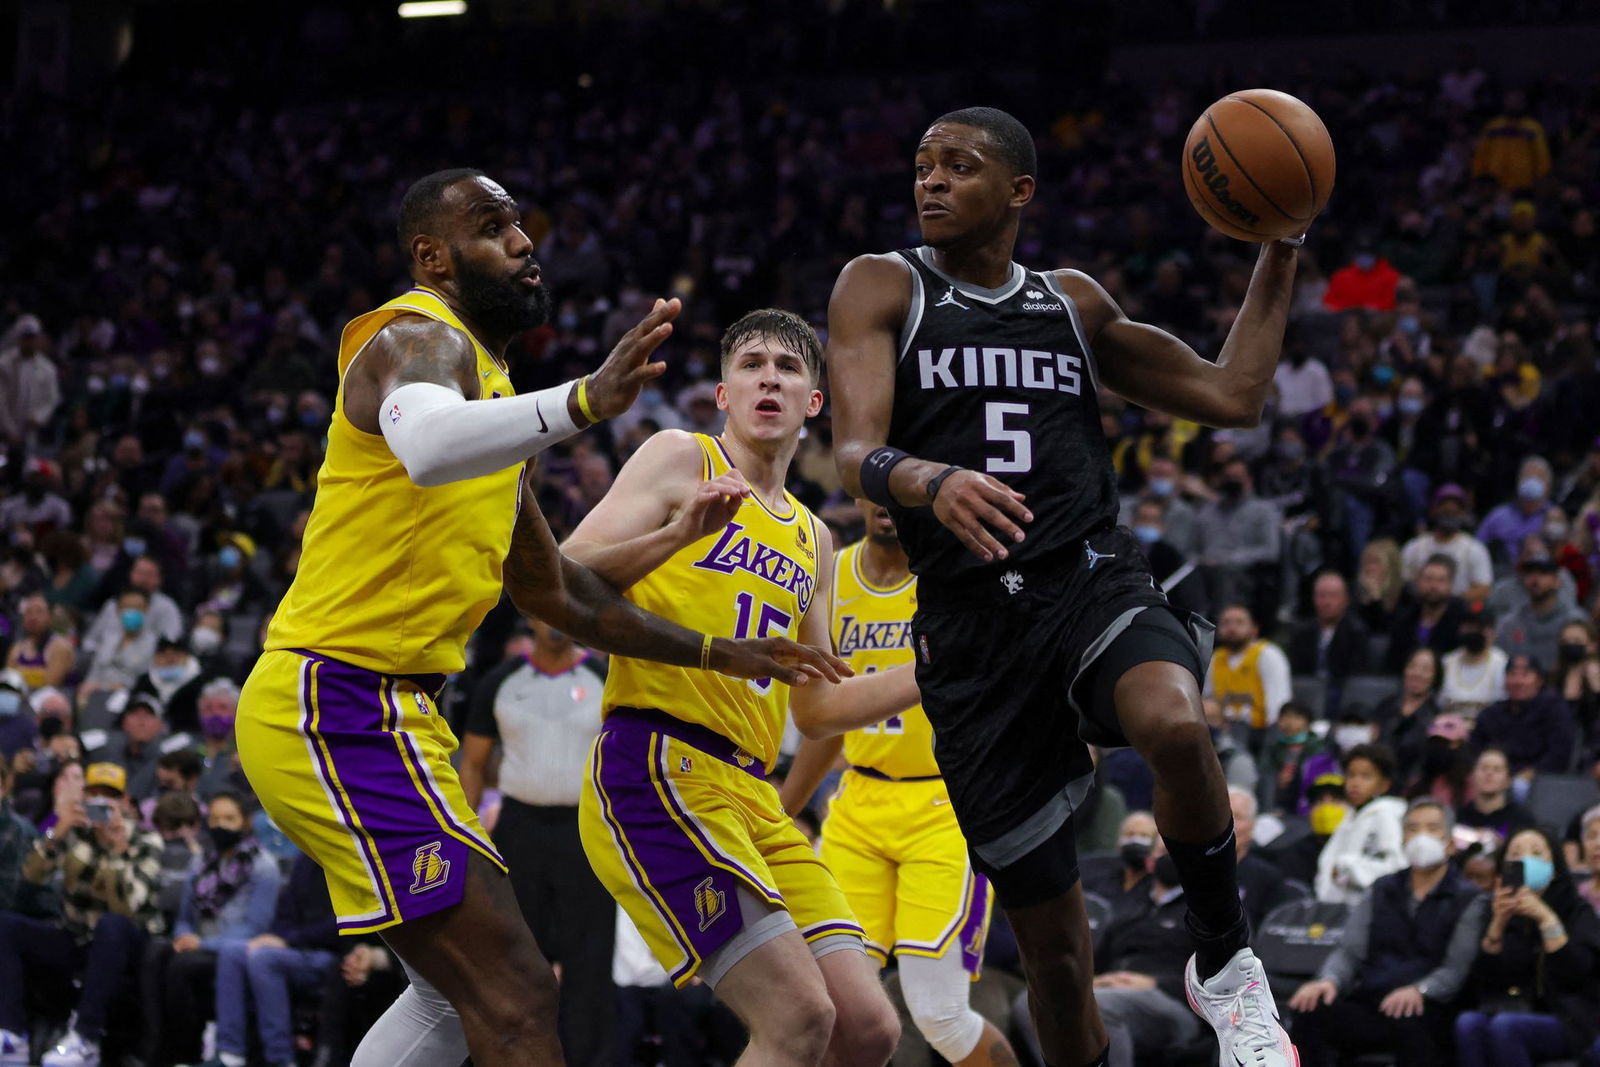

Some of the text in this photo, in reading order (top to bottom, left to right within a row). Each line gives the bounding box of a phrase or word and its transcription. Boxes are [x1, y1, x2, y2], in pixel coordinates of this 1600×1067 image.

[1194, 137, 1260, 226] Wilson
[1022, 302, 1062, 311] dialpad
[917, 346, 1082, 396] KINGS
[984, 401, 1032, 473] 5
[691, 520, 814, 615] LAKERS
[838, 614, 915, 658] LAKER
